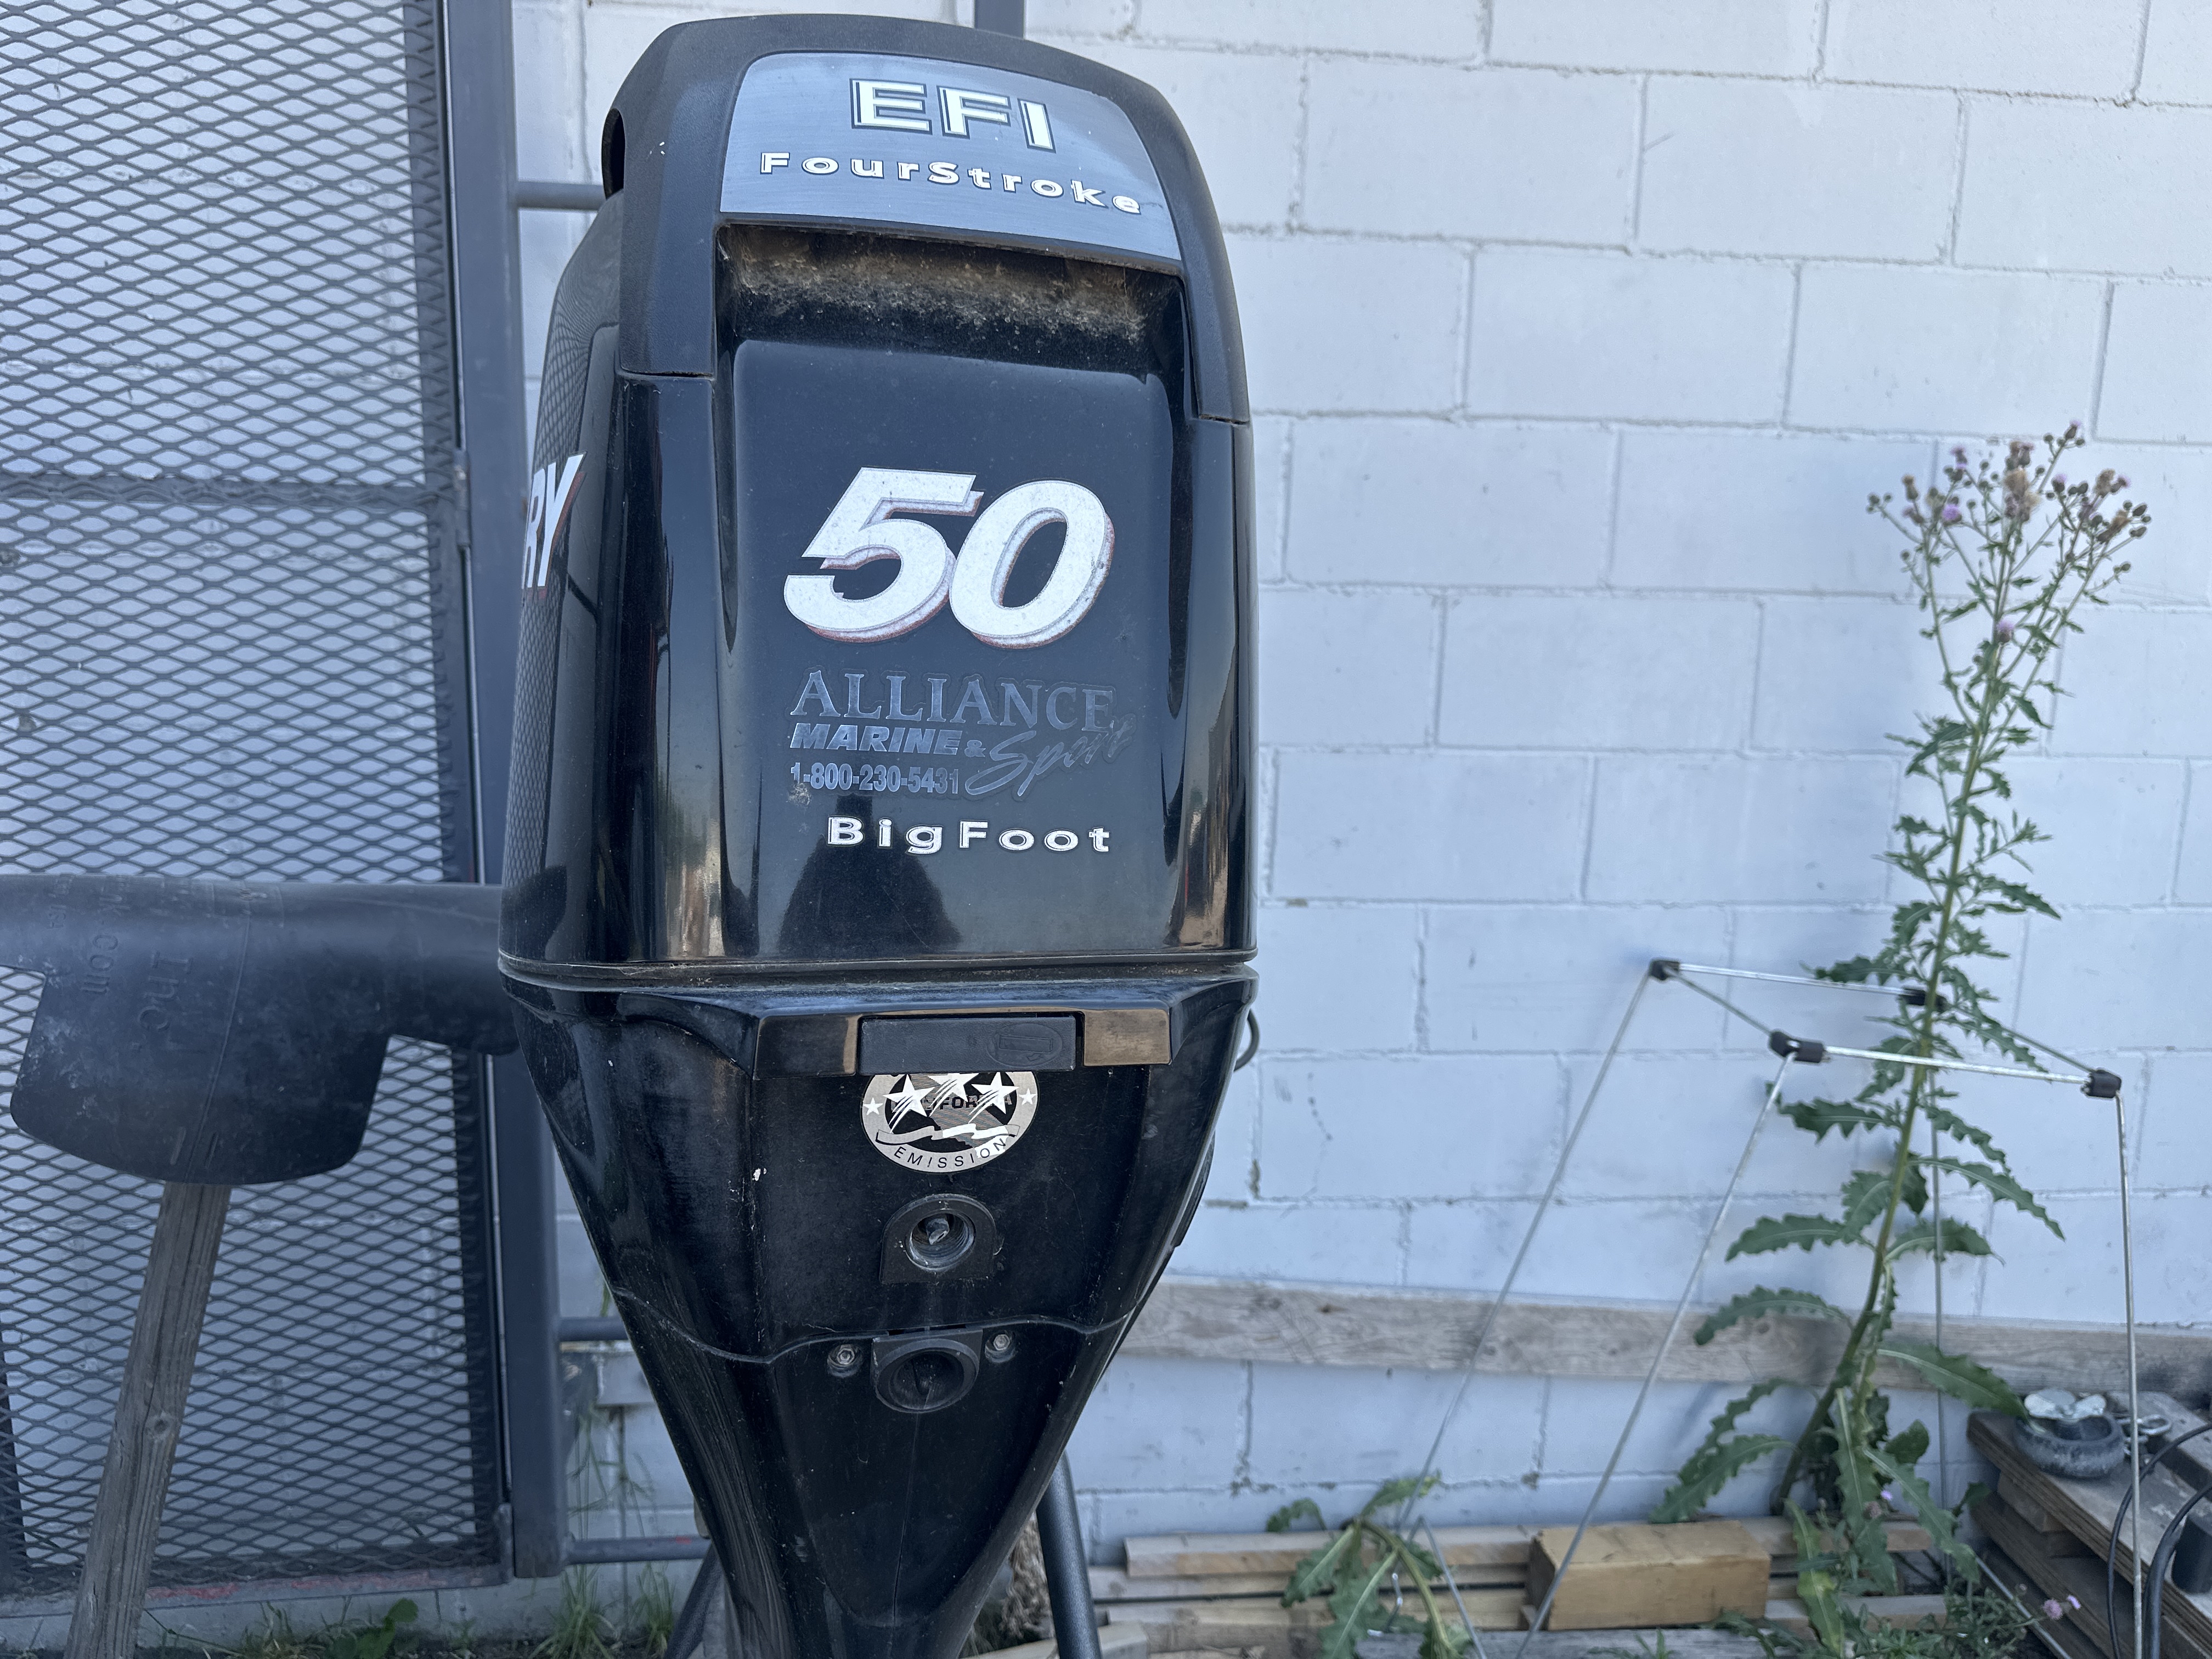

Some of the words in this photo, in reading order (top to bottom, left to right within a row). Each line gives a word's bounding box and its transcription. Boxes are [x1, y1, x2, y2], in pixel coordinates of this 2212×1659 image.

[849, 78, 1056, 153] EFI
[760, 151, 1142, 215] FourStroke
[783, 466, 1116, 650] 50
[789, 669, 1114, 732] ALLIANCE
[789, 723, 963, 756] MARINE
[790, 761, 959, 795] 1-800-230-5431
[826, 816, 1110, 855] BigFoot
[894, 1138, 1006, 1169] EMISSION
